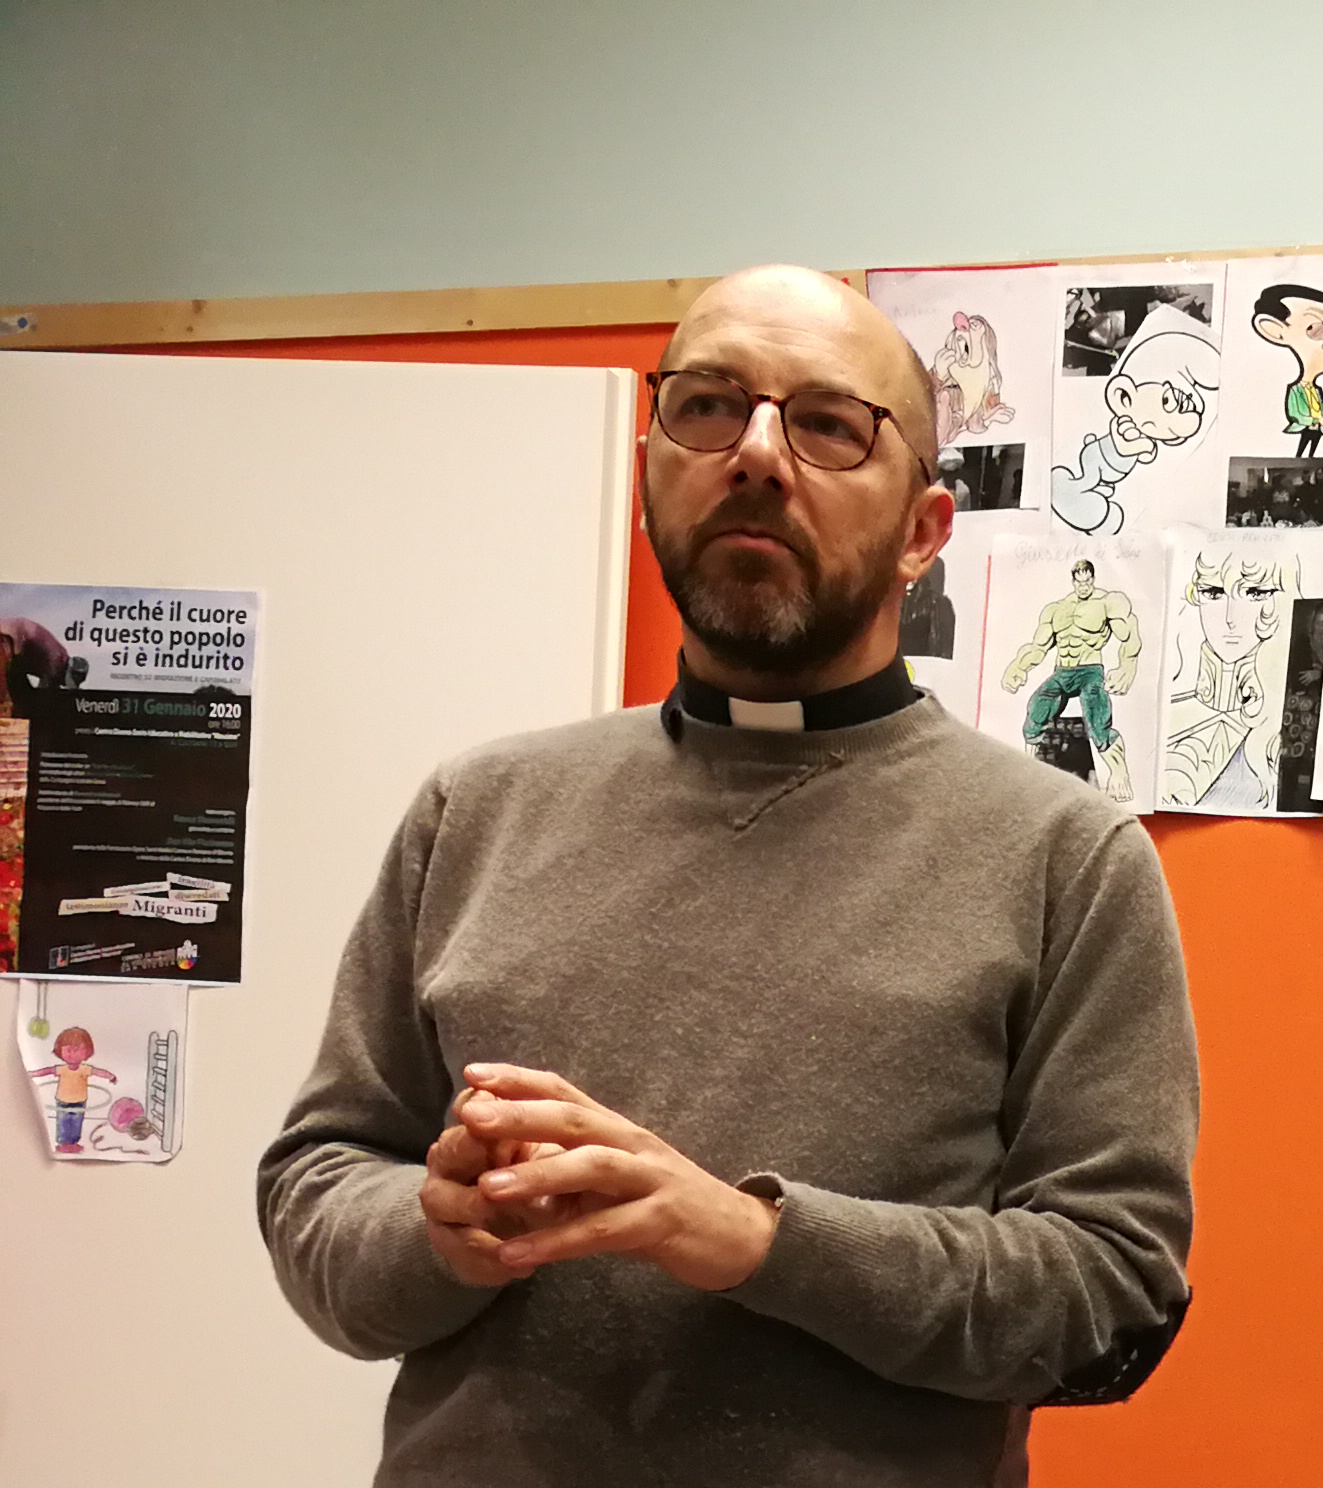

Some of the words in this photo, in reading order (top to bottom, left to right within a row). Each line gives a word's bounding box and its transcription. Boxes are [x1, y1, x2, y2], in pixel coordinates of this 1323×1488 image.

[92, 599, 164, 621] Perché
[169, 600, 182, 622] il
[187, 606, 247, 624] cuore
[64, 620, 85, 642] di
[90, 626, 164, 647] questo
[169, 626, 246, 651] popolo
[111, 646, 129, 666] si
[135, 646, 148, 667] è
[153, 647, 245, 671] indurito
[208, 702, 242, 718] 2020
[132, 899, 207, 918] Migranti
